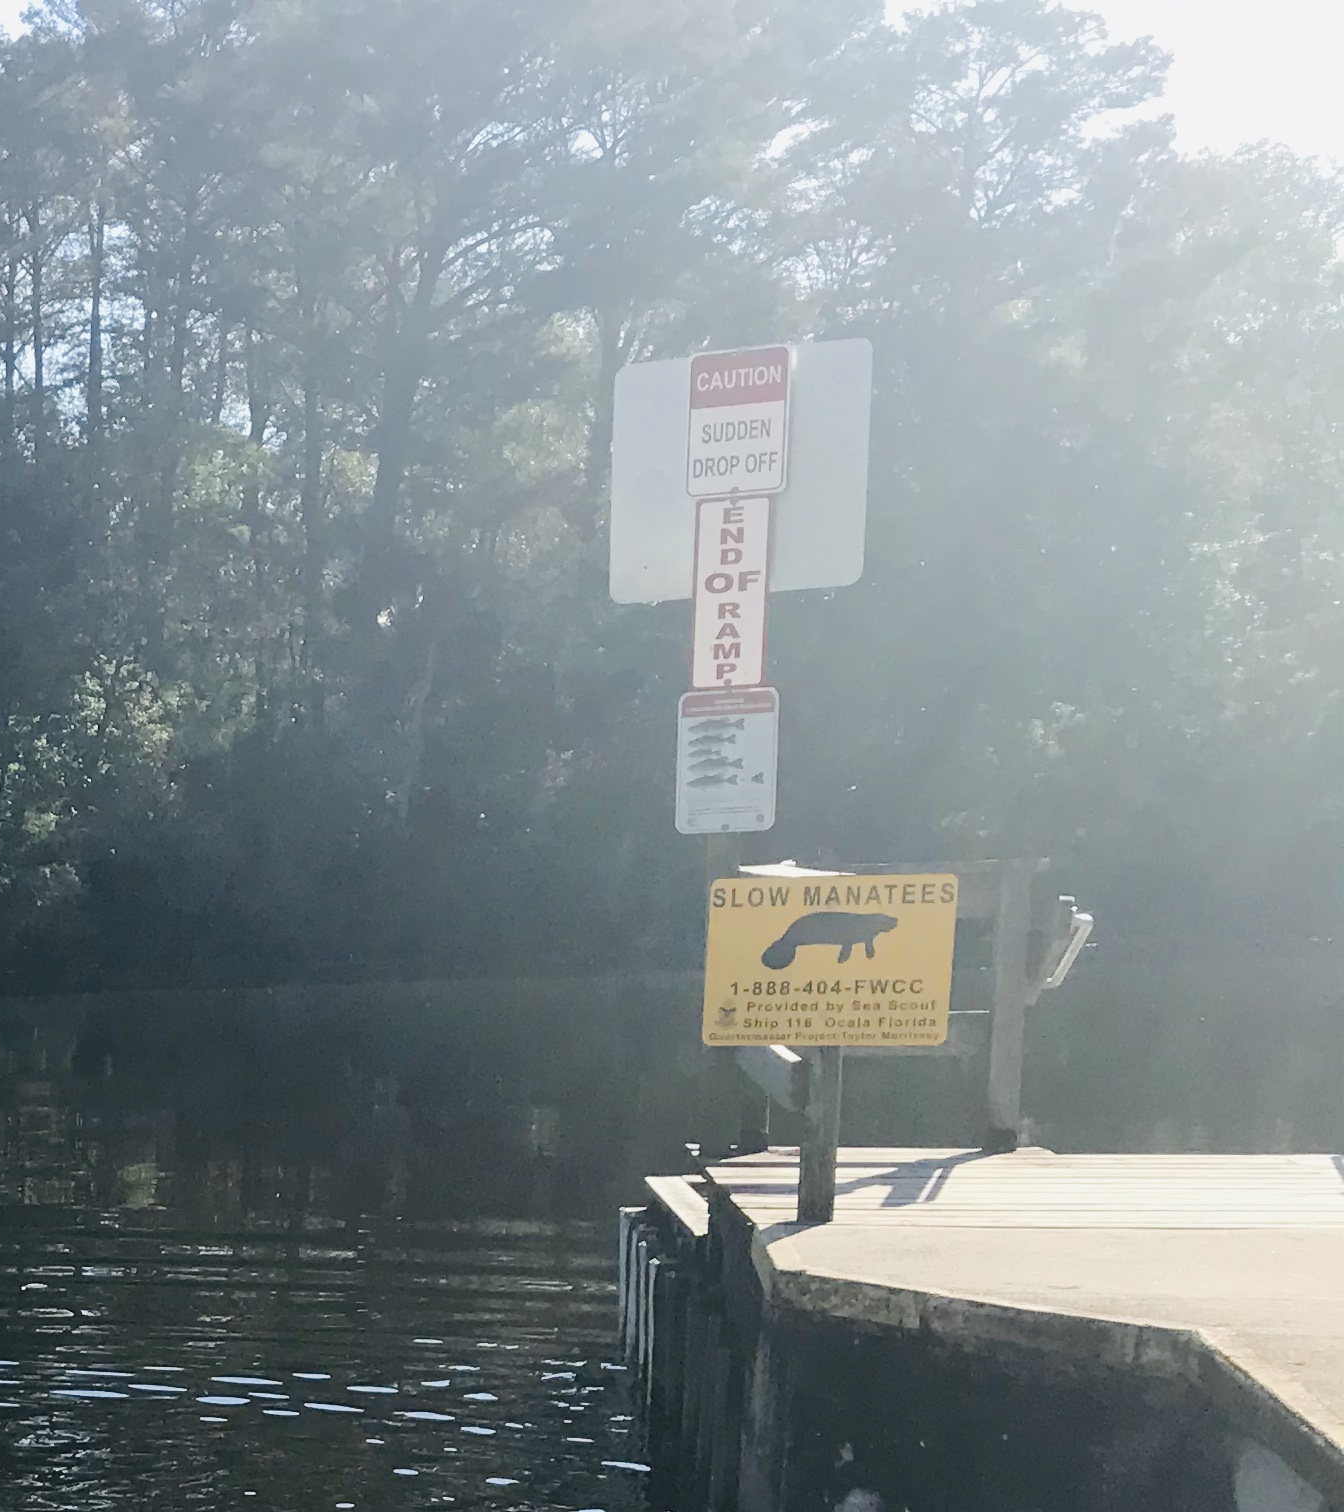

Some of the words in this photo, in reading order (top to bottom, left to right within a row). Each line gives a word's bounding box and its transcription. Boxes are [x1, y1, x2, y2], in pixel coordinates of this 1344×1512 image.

[696, 365, 783, 392] CAUTION
[701, 418, 772, 444] SUDDEN
[693, 455, 741, 479] DROP
[744, 451, 779, 473] OFF
[719, 506, 745, 565] END
[704, 570, 761, 594] OF
[713, 602, 741, 680] RAMP
[712, 886, 790, 908] SLOW
[803, 882, 956, 907] MANATEES
[730, 979, 924, 996] 1-888-404-FWCC
[746, 1001, 819, 1012] Provided
[825, 1001, 844, 1013] by
[852, 1000, 881, 1011] Sea
[888, 1000, 936, 1011] Scout
[743, 1017, 779, 1029] Ship
[825, 1017, 870, 1028] Ocala
[878, 1016, 937, 1028] Florida
